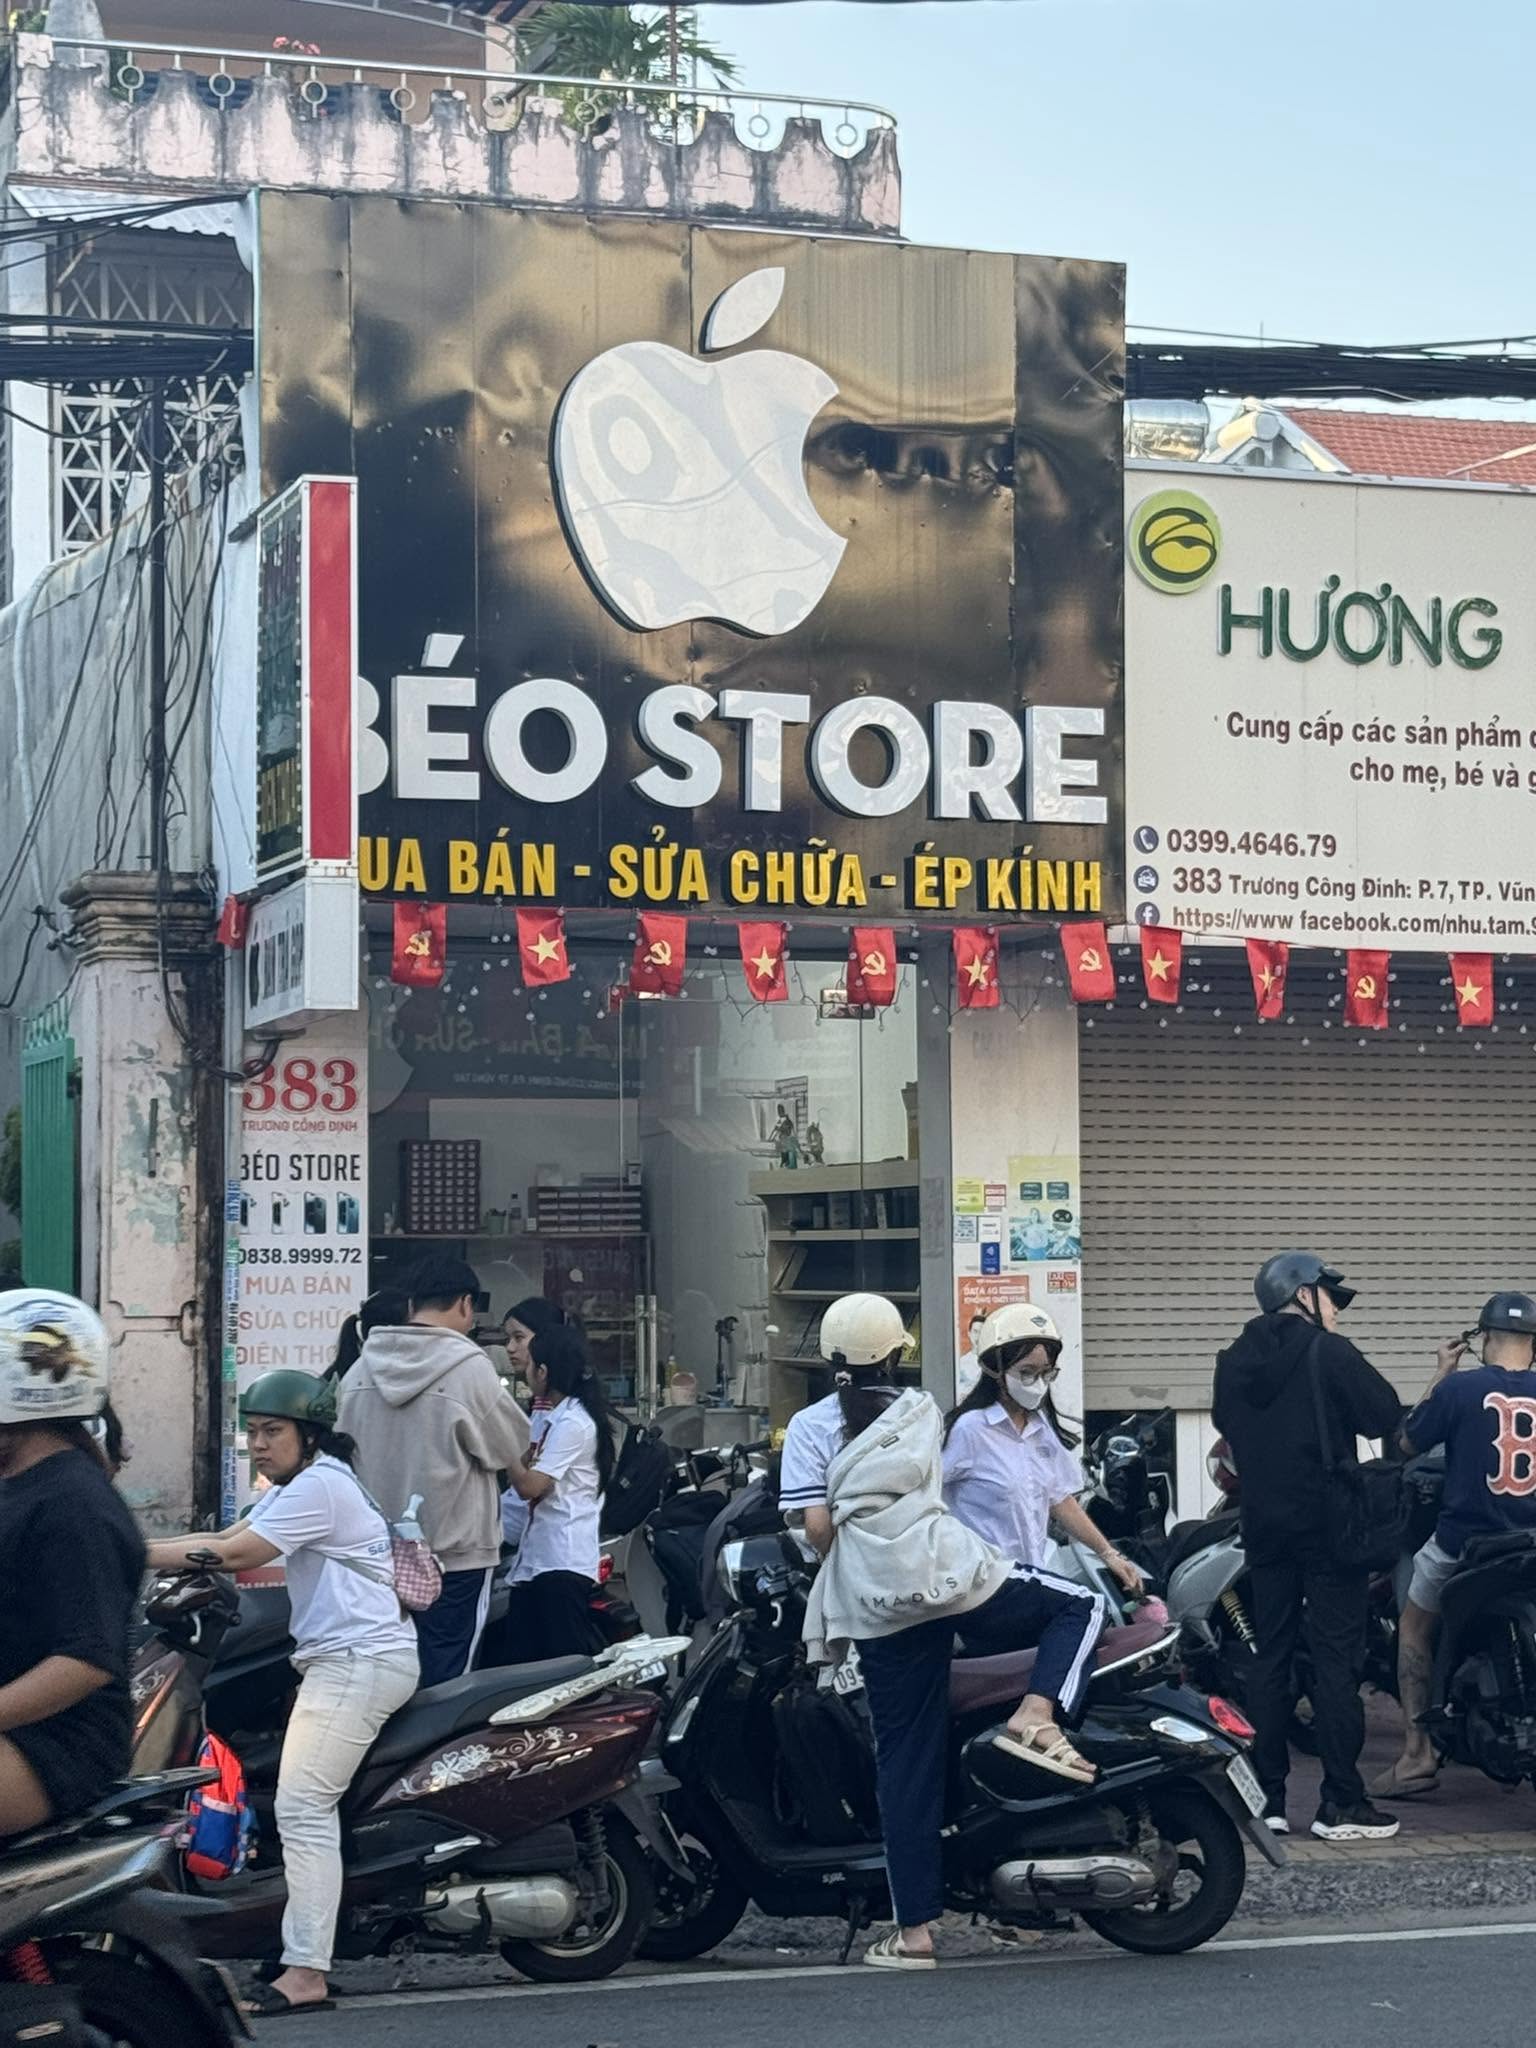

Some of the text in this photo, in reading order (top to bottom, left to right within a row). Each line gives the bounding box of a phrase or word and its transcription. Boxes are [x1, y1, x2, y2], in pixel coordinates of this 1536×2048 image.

[1216, 573, 1505, 671] HƯƠNG
[1226, 711, 1290, 745] Cung
[1299, 709, 1344, 747] cấp
[1351, 716, 1396, 743] các
[1404, 714, 1448, 746] sản
[1455, 714, 1522, 751] phẩm
[630, 684, 1109, 825] STORE
[1349, 756, 1394, 783] cho
[1402, 765, 1447, 793] mẹ,
[1455, 761, 1484, 787] bé
[1492, 762, 1520, 788] và
[1166, 828, 1338, 858] 0399.4646.79
[448, 827, 556, 898] BÁN
[573, 864, 592, 877] -
[608, 824, 709, 903] SỬA
[730, 837, 868, 907] CHỮA
[914, 840, 972, 909] ÉP
[986, 843, 1102, 913] KÍNH
[1172, 866, 1222, 894] 383
[1228, 874, 1300, 900] Trương
[1305, 875, 1356, 901] Công
[242, 1057, 357, 1114] 383
[240, 1149, 361, 1181] BÉO STORE
[238, 1247, 362, 1265] 0838.9999.72
[245, 1271, 352, 1295] MUA BÁN
[239, 1304, 288, 1330] SỬA
[293, 1305, 353, 1330] CHỮ
[236, 1341, 288, 1371] ĐIỆN
[1483, 1392, 1536, 1497] B
